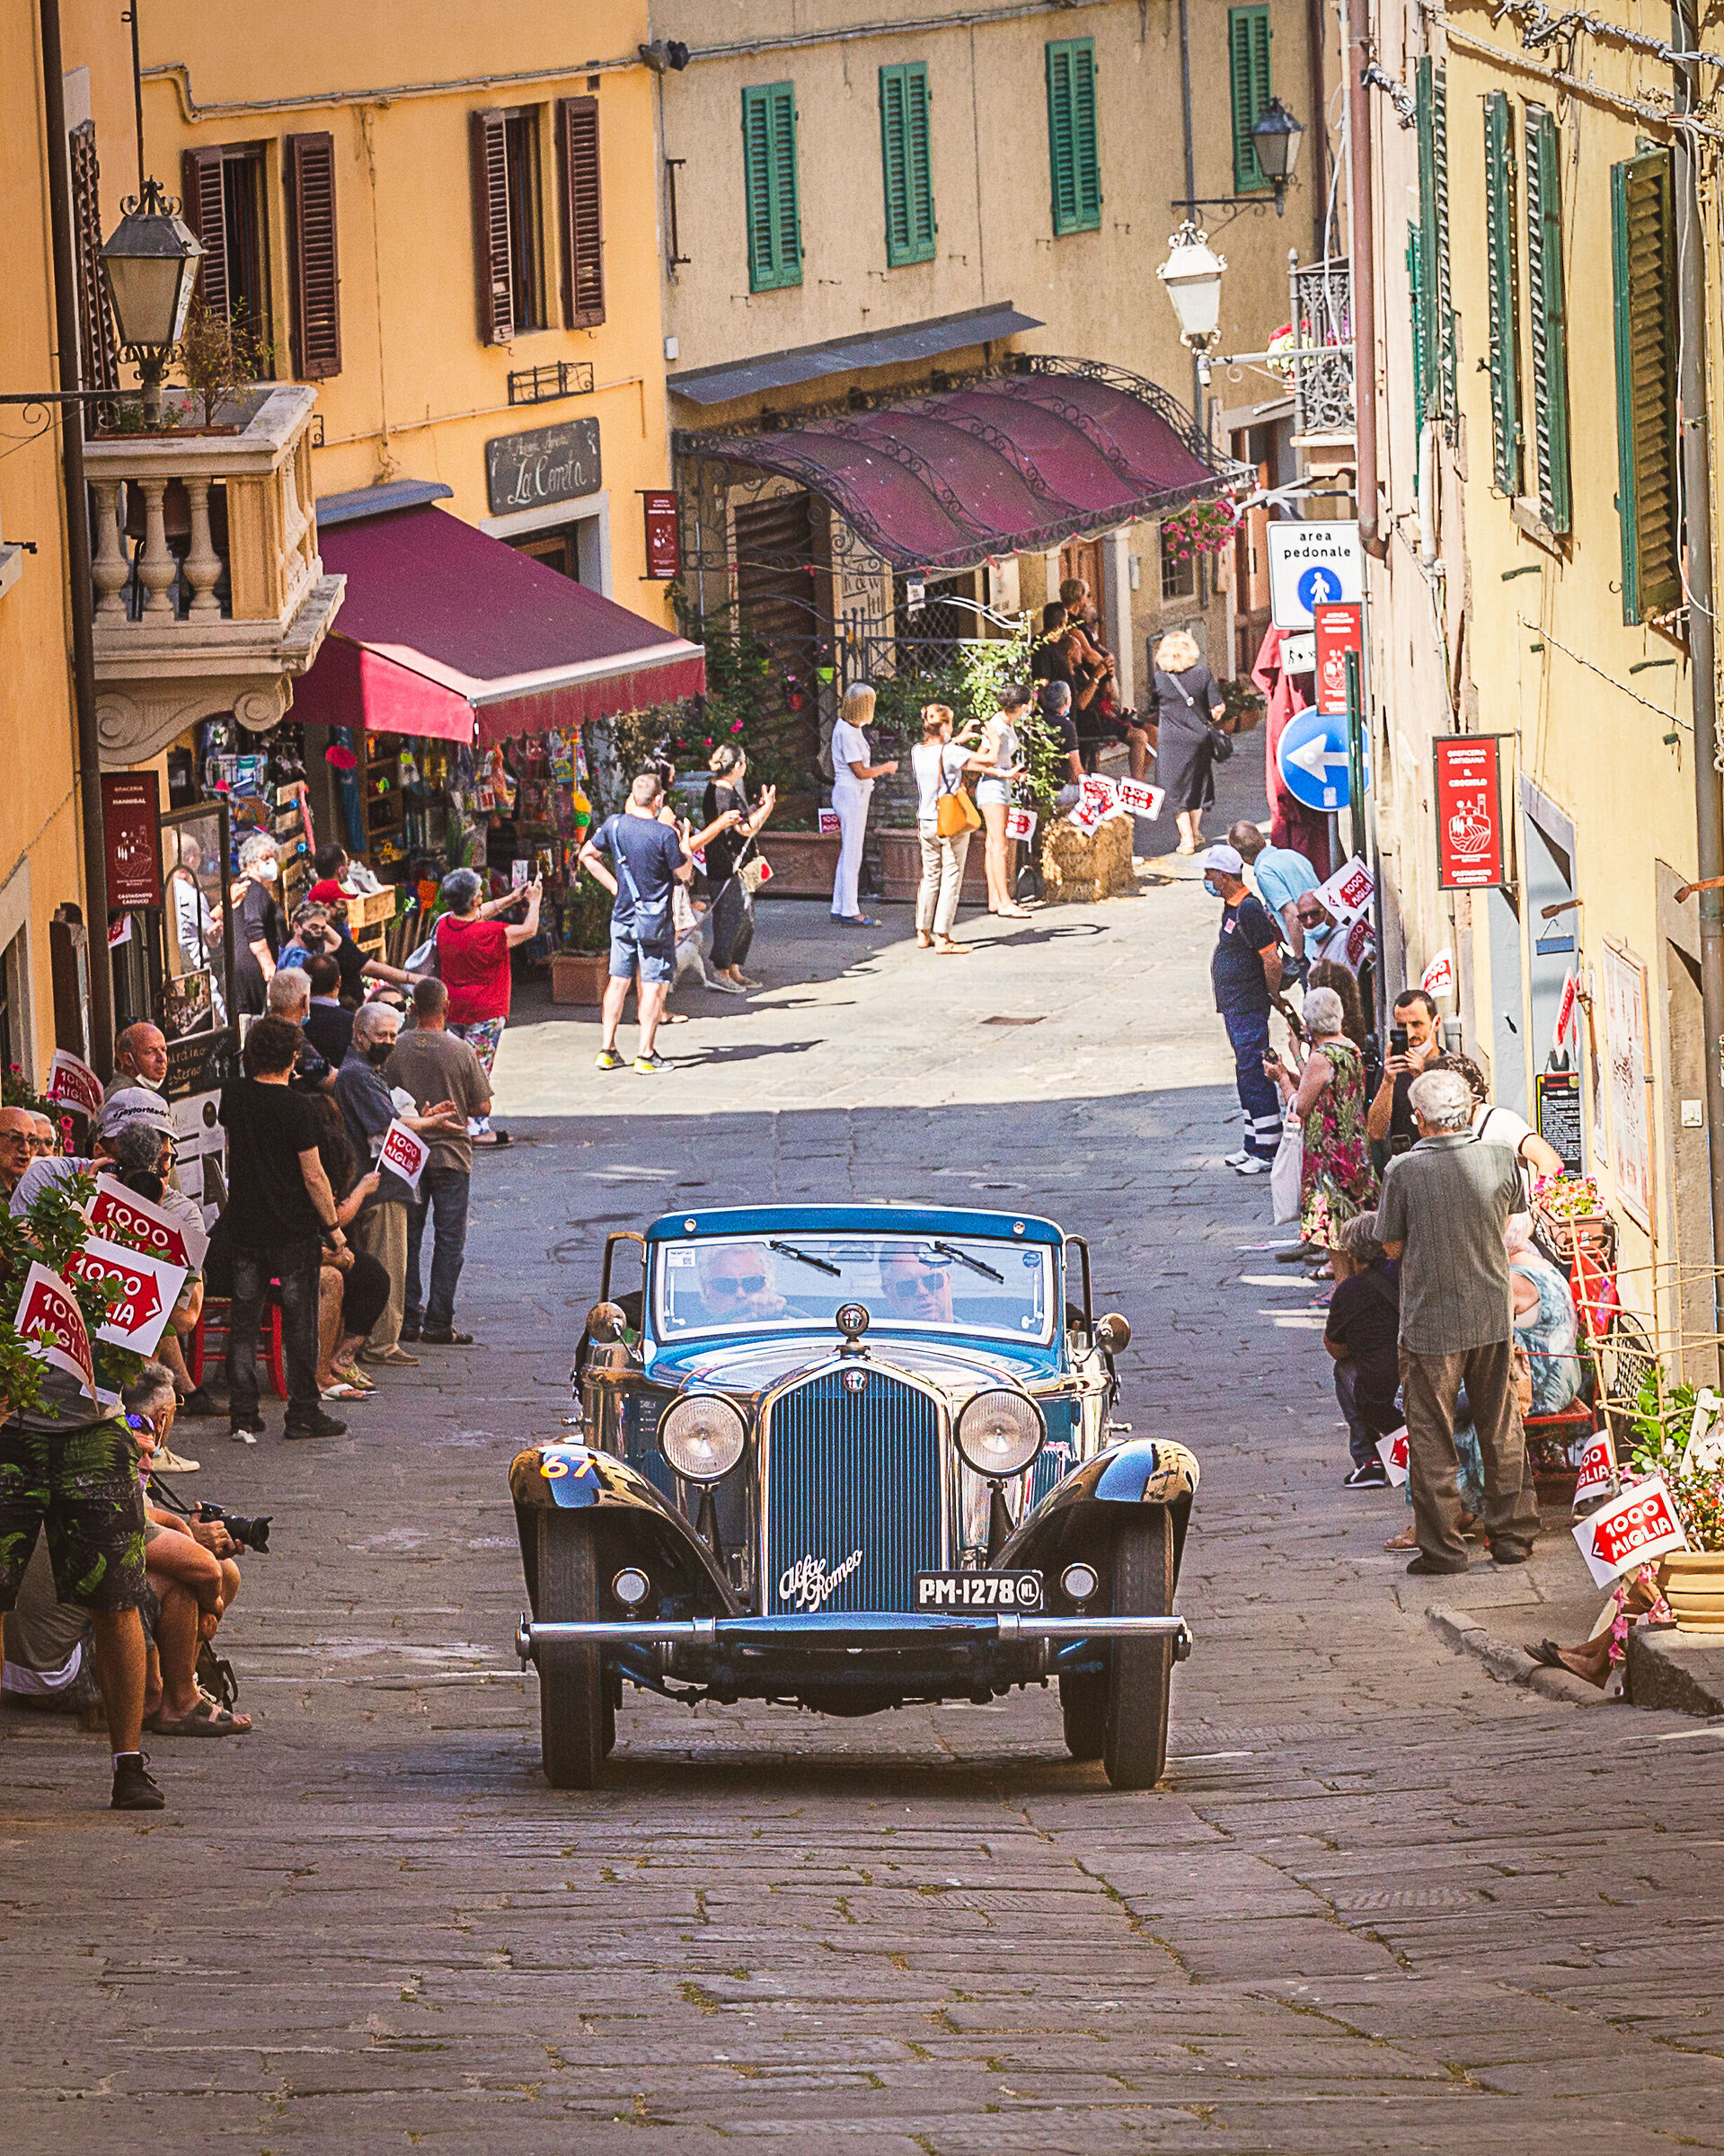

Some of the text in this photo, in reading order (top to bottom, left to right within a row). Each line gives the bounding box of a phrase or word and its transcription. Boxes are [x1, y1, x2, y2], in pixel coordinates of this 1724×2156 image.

[1284, 546, 1351, 560] pedonale
[1299, 533, 1332, 542] area
[393, 1134, 418, 1158] 1000
[106, 1202, 168, 1246] 1000
[43, 1294, 85, 1345] 1000
[540, 1455, 597, 1479] 67
[1605, 1499, 1658, 1538] 1000
[1611, 1516, 1672, 1559] MIGLIA
[804, 1550, 862, 1613] Romeo
[919, 1578, 1035, 1604] PM-1278 NL
